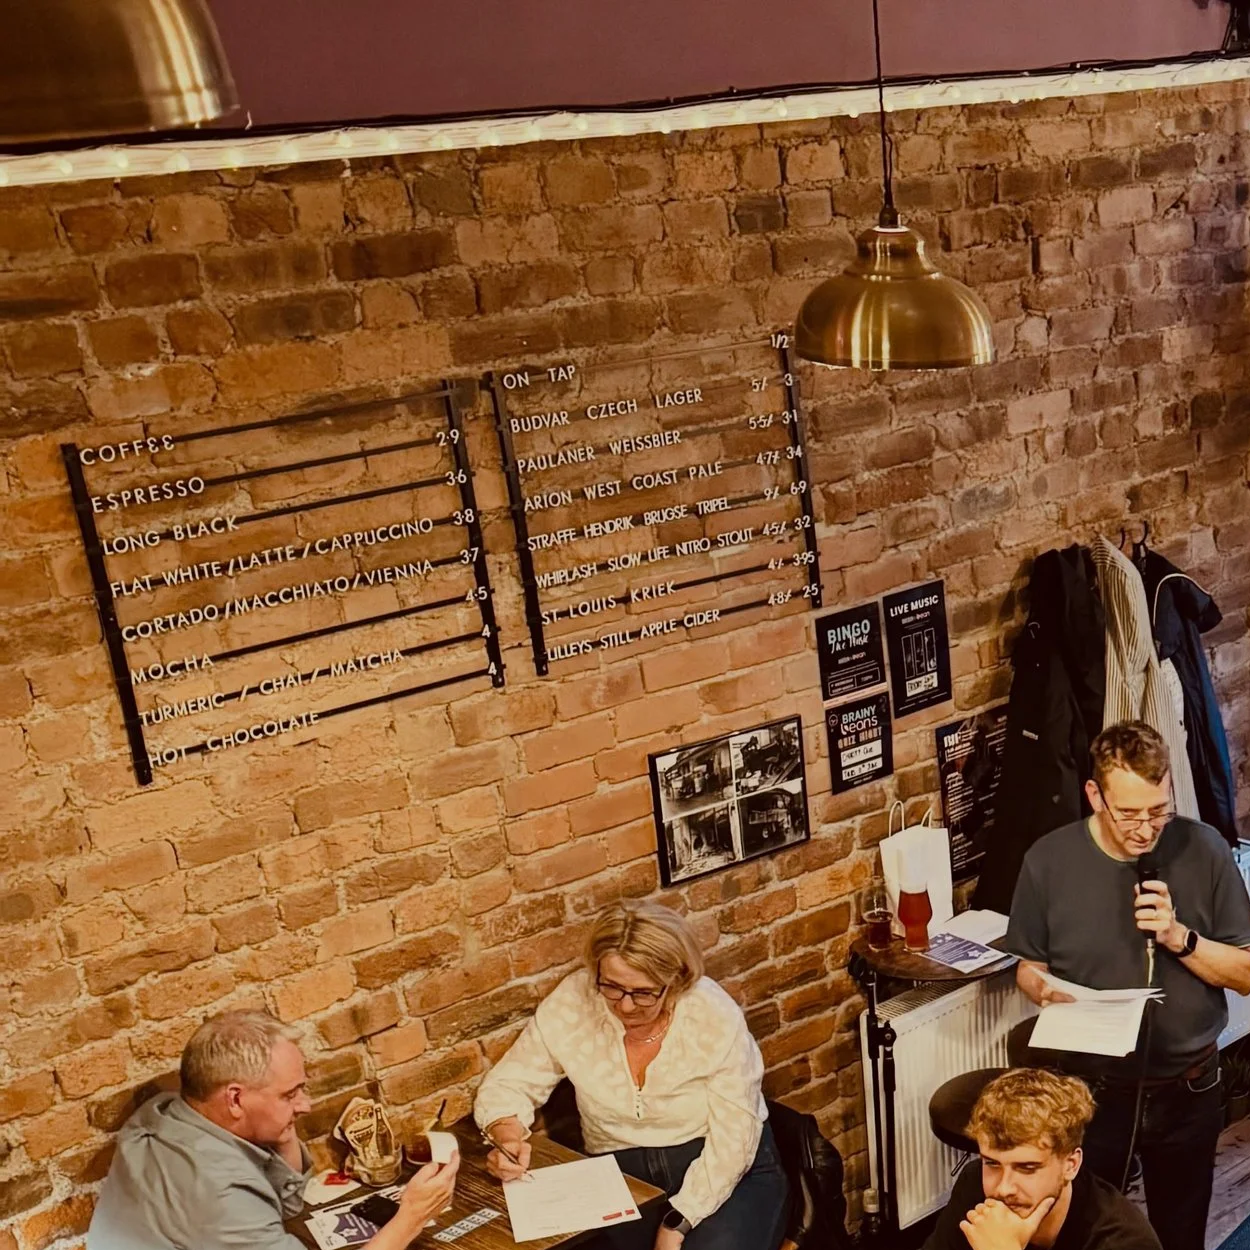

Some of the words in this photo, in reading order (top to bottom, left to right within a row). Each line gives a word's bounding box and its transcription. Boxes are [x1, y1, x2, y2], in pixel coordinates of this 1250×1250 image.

[503, 372, 529, 389] ON
[548, 365, 576, 383] TAP
[771, 333, 789, 349] 1/2
[510, 411, 570, 434] BUDVAR
[587, 399, 637, 420] CZECH
[656, 388, 703, 409] LAGER
[784, 373, 793, 386] 3
[517, 447, 596, 474] PAULANER
[609, 431, 682, 456] WEISSBIER
[91, 476, 205, 514] ESPRESSO
[523, 490, 573, 512] ARION
[584, 480, 621, 501] WEST
[632, 470, 679, 491] COAST
[688, 461, 722, 480] PALE
[102, 530, 160, 556] LONG
[173, 515, 240, 541] BLACK
[527, 527, 577, 551] STRAFFE
[584, 515, 634, 539] HENDRIK
[644, 504, 688, 526] BRUGSE
[696, 497, 731, 515] TRIPEL
[534, 562, 598, 589] WHIPLASH
[608, 552, 641, 572] SLOW
[648, 546, 670, 563] LIFE
[675, 538, 711, 557] NITRO
[717, 527, 754, 547] STOUT
[110, 574, 153, 599] FLAT
[541, 608, 562, 625] ST.
[569, 594, 616, 618] LOUIS
[630, 580, 677, 603] KRIEK
[890, 603, 909, 617] LIVE
[910, 595, 939, 611] MUSIC
[546, 639, 592, 662] LILLEYS
[600, 630, 634, 650] STILL
[640, 618, 677, 640] APPLE
[684, 608, 721, 628] CIDER
[827, 619, 870, 645] BINGO
[130, 653, 215, 686] MOCHA
[138, 692, 225, 727] TURMERIC
[259, 674, 303, 695] CHAI
[330, 648, 404, 679] MATCHA
[482, 624, 491, 638] 4
[148, 746, 188, 769] HOT
[206, 710, 320, 752] CHOCOLATE
[488, 661, 497, 675] 4
[842, 705, 876, 724] BRAINY
